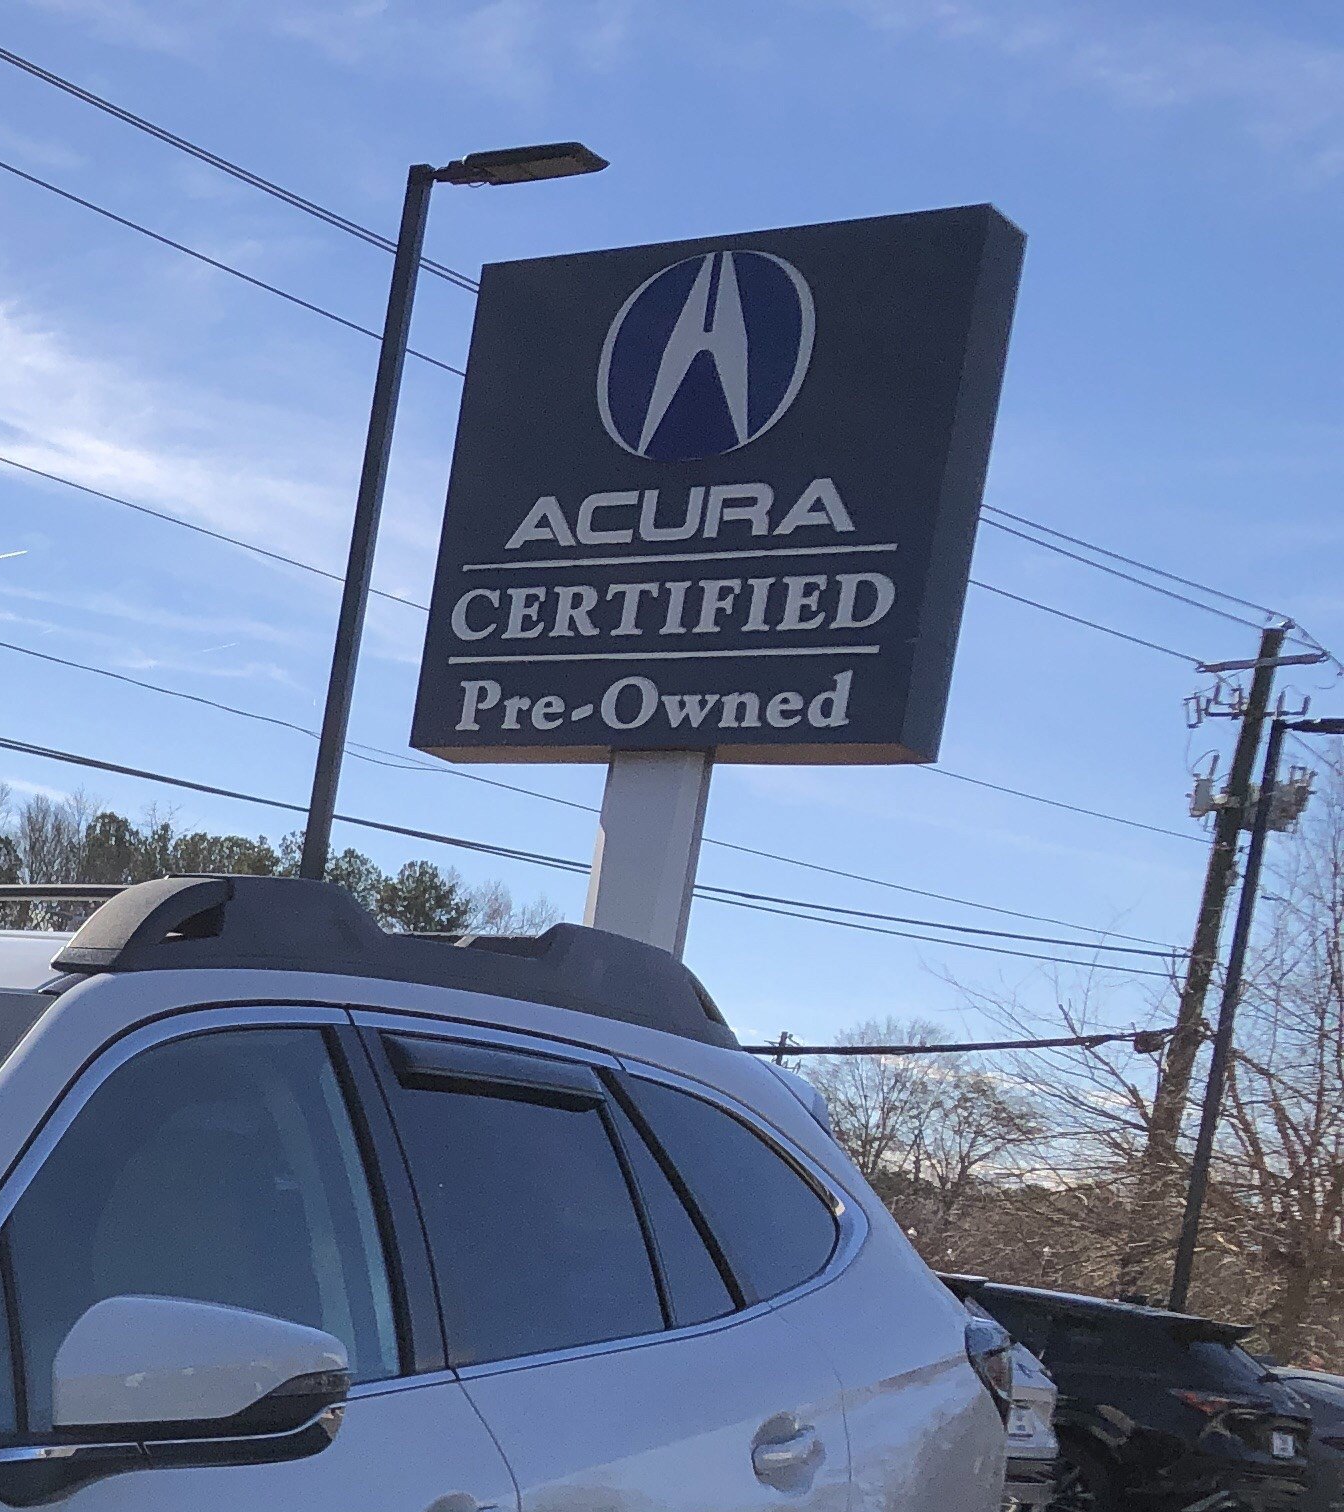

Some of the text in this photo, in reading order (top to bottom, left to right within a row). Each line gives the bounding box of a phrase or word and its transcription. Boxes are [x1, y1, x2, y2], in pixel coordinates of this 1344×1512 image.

[504, 477, 856, 550] ACURA
[450, 571, 896, 641] CERTIFIED
[454, 669, 854, 732] Pre-Owned
